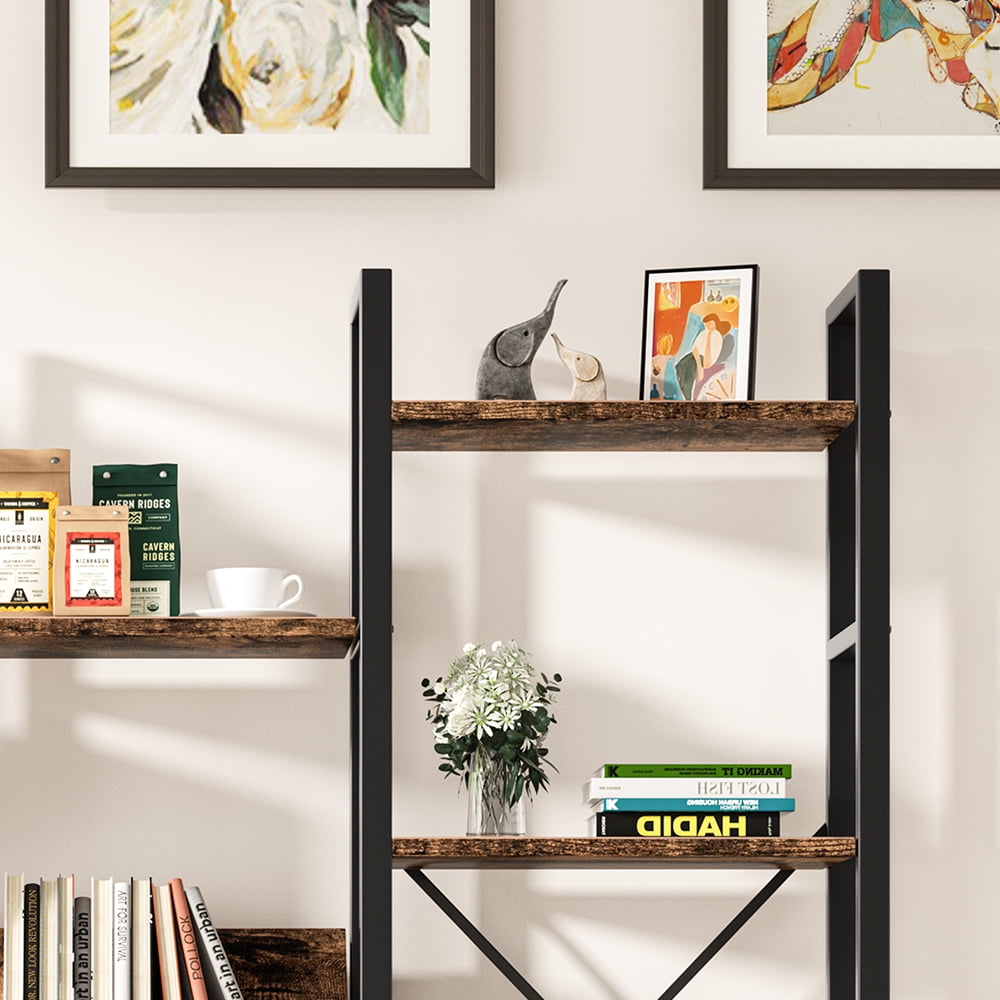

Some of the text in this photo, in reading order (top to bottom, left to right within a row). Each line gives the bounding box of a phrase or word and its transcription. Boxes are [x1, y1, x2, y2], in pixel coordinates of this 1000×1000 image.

[138, 499, 171, 508] RIDGES
[143, 542, 175, 551] CAVERN
[143, 552, 176, 562] RIDGES
[28, 890, 36, 988] NEW LOOK REVOLUTION
[74, 912, 88, 949] urban
[118, 890, 128, 962] ART FOR SURVIVAL
[78, 953, 88, 968] an
[180, 916, 202, 980] POLLOCK
[196, 902, 241, 1000] art in an urban
[74, 972, 88, 984] in
